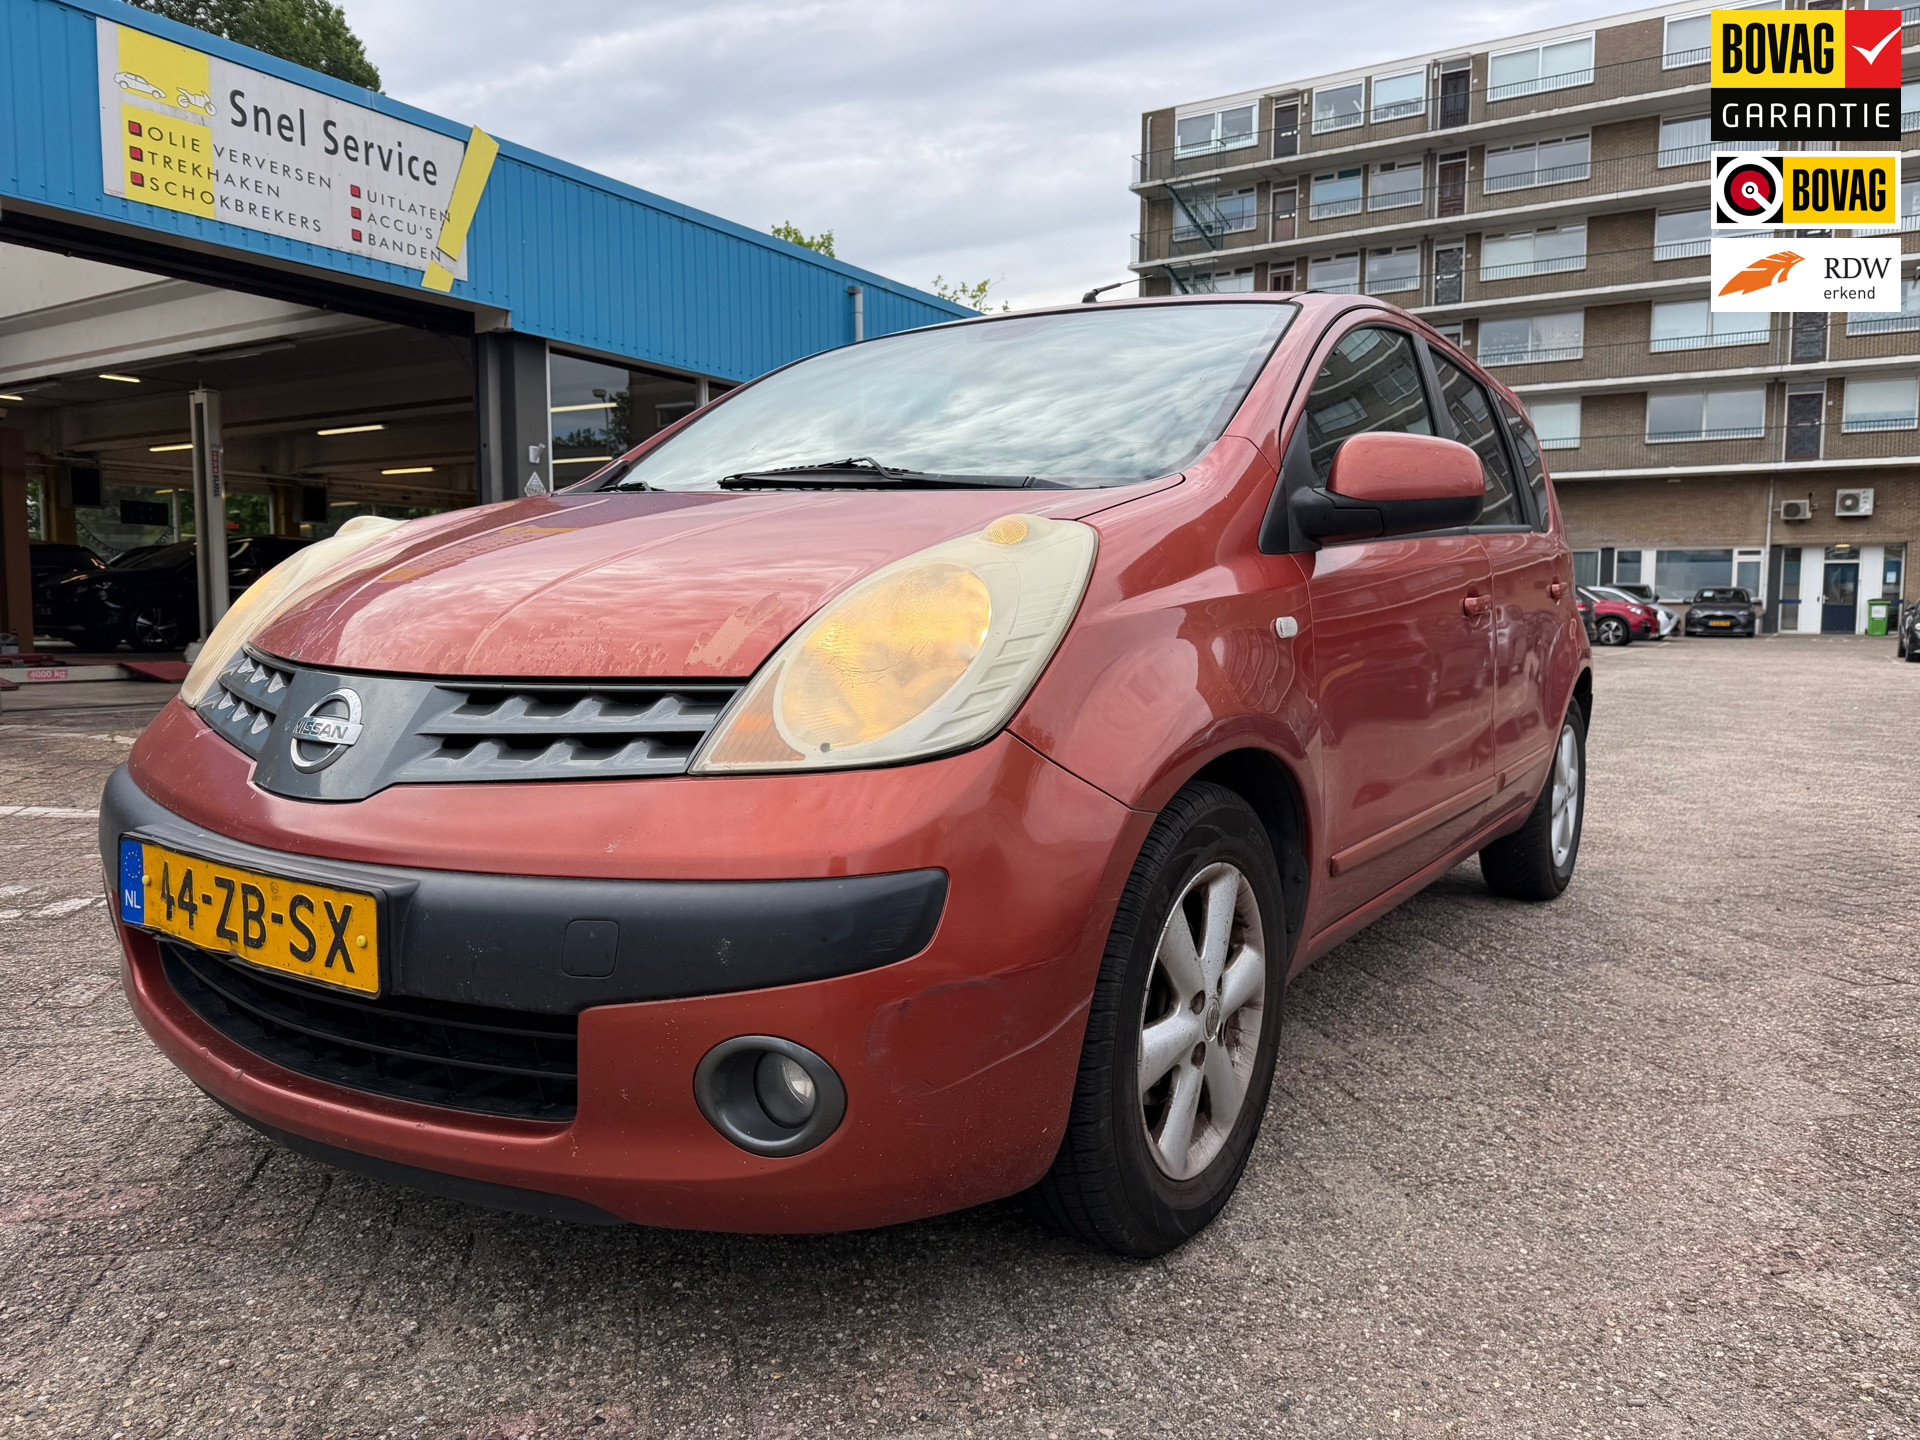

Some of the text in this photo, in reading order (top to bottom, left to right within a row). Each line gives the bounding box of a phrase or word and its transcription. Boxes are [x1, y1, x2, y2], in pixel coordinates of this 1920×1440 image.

[230, 88, 438, 187] Snel Service
[147, 126, 332, 190] OLIE VERVERSEN
[148, 150, 280, 199] TREKHAKEN
[149, 177, 322, 233] SCHOKBREKERS
[367, 189, 452, 224] UITLATEN
[367, 212, 433, 240] ACCU'S
[368, 233, 441, 263] BANDEN
[30, 669, 66, 679] 4000 kg
[292, 720, 350, 740] NISSAN
[124, 888, 142, 909] NL
[159, 860, 356, 974] 44-ZB-SX
